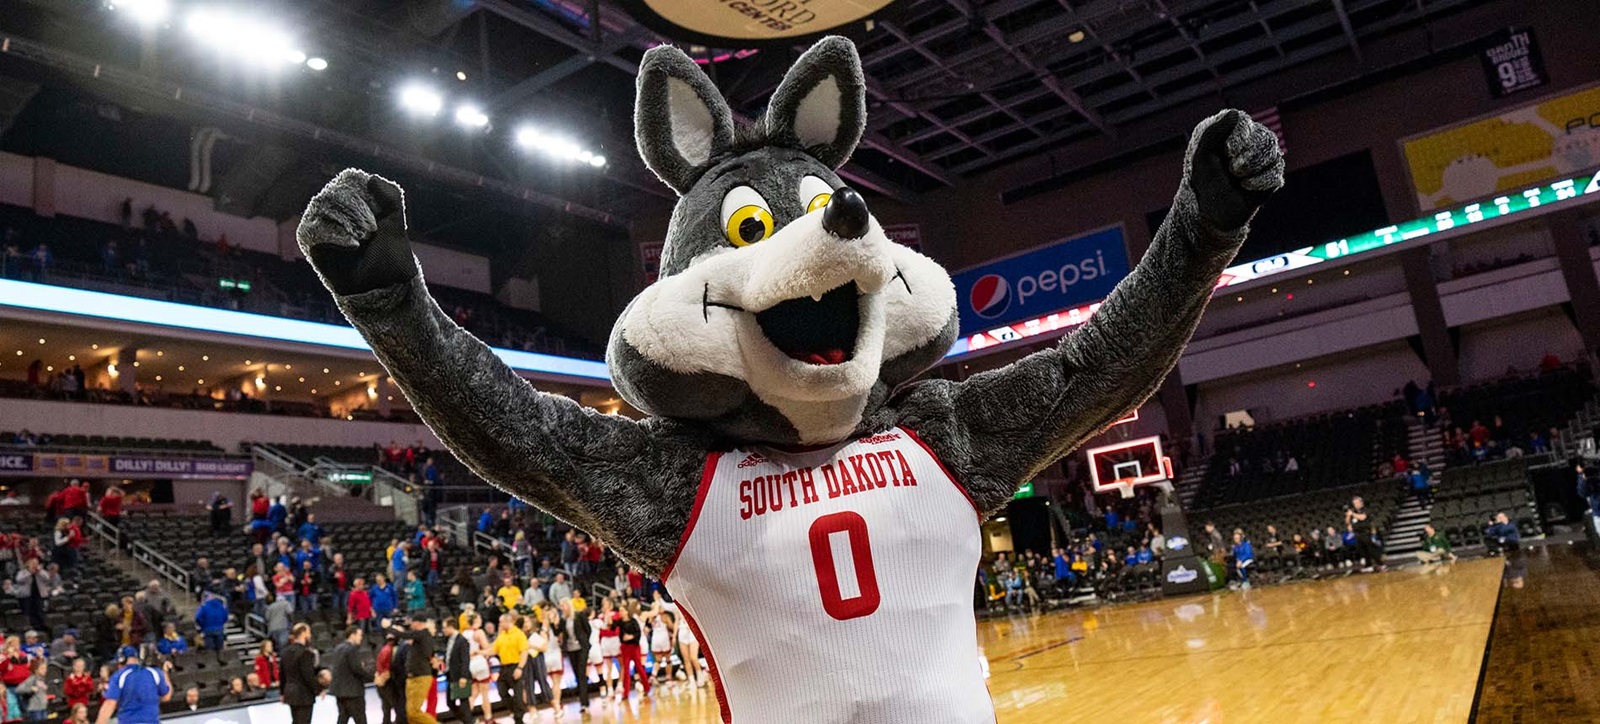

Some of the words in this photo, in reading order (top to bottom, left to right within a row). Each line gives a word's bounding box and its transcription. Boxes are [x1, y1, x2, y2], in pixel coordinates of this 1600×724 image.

[728, 1, 793, 31] CENTER
[1498, 62, 1517, 88] 9
[1017, 249, 1106, 305] pepsi
[739, 468, 819, 520] SOUTH
[821, 450, 917, 498] DAKOTA
[808, 510, 882, 621] 0
